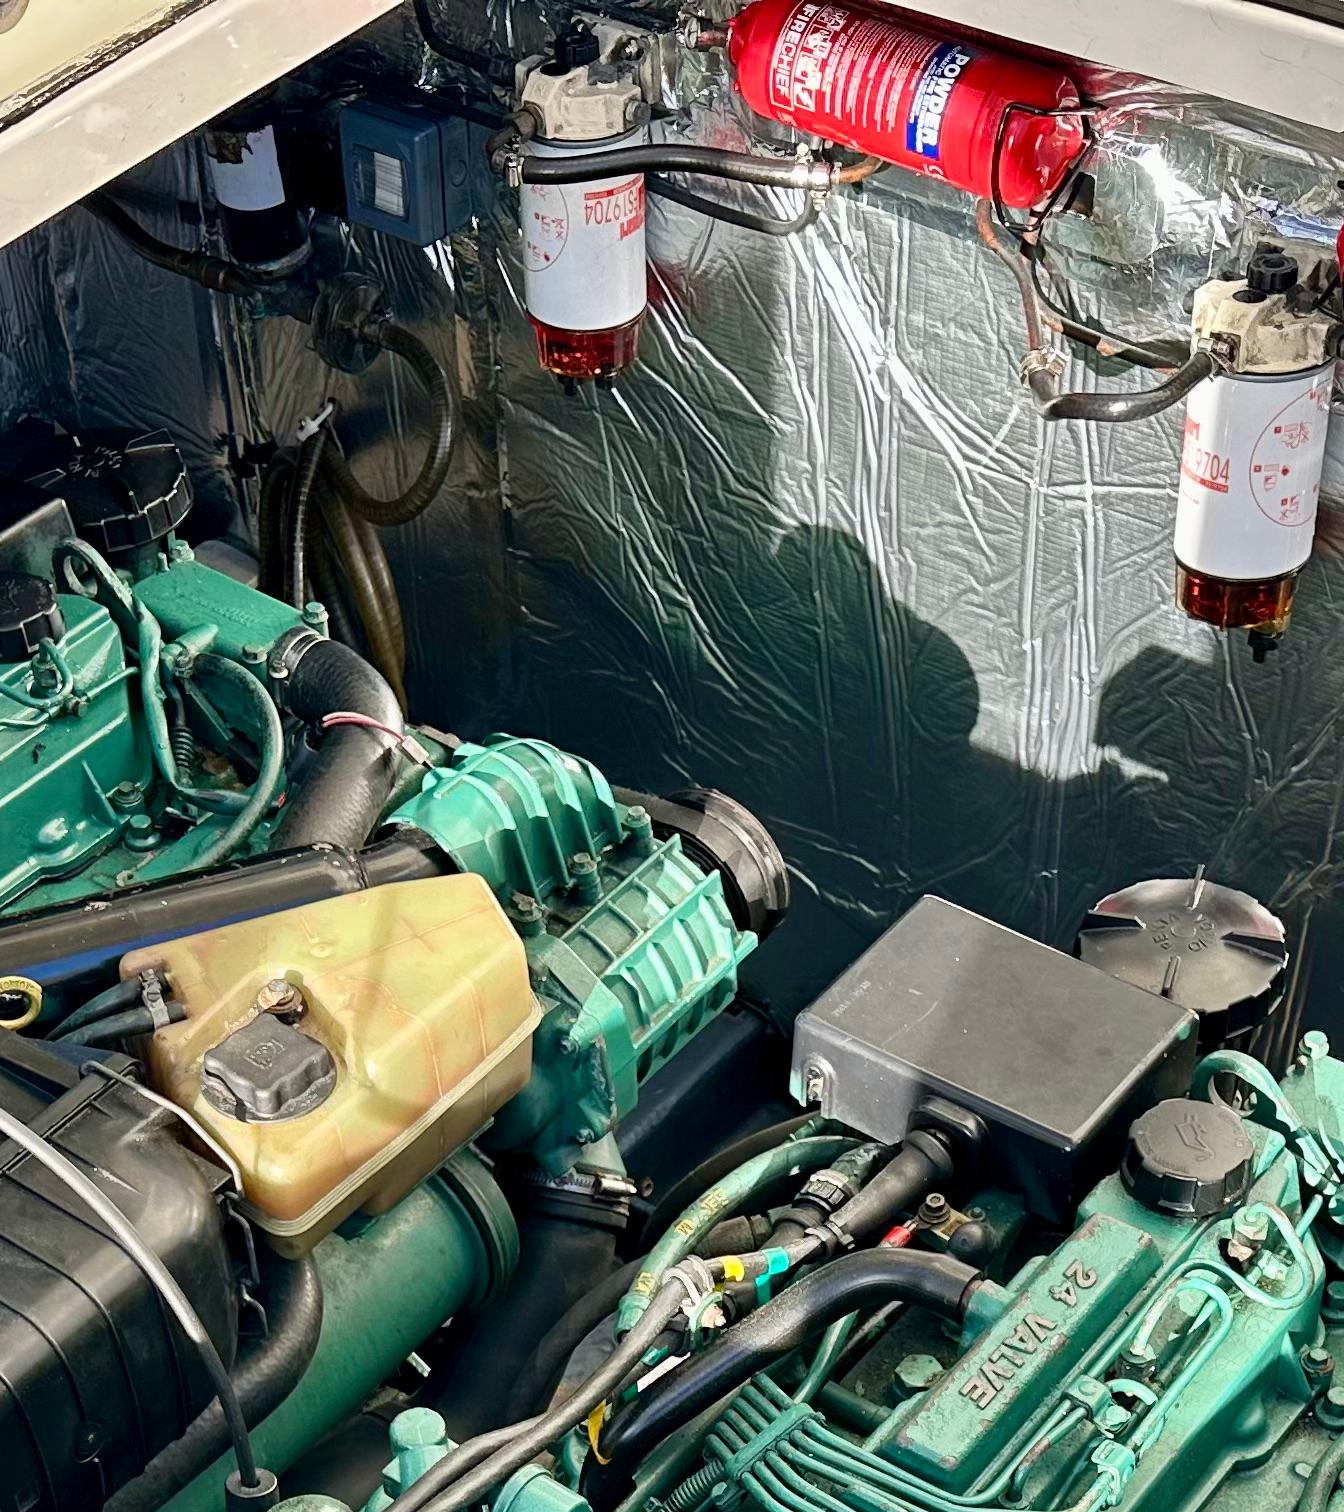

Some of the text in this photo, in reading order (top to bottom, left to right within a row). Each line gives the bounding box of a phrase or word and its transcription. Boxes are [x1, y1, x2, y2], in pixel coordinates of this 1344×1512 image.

[921, 53, 970, 146] POWDER
[958, 1258, 1098, 1410] 24 VALVE
